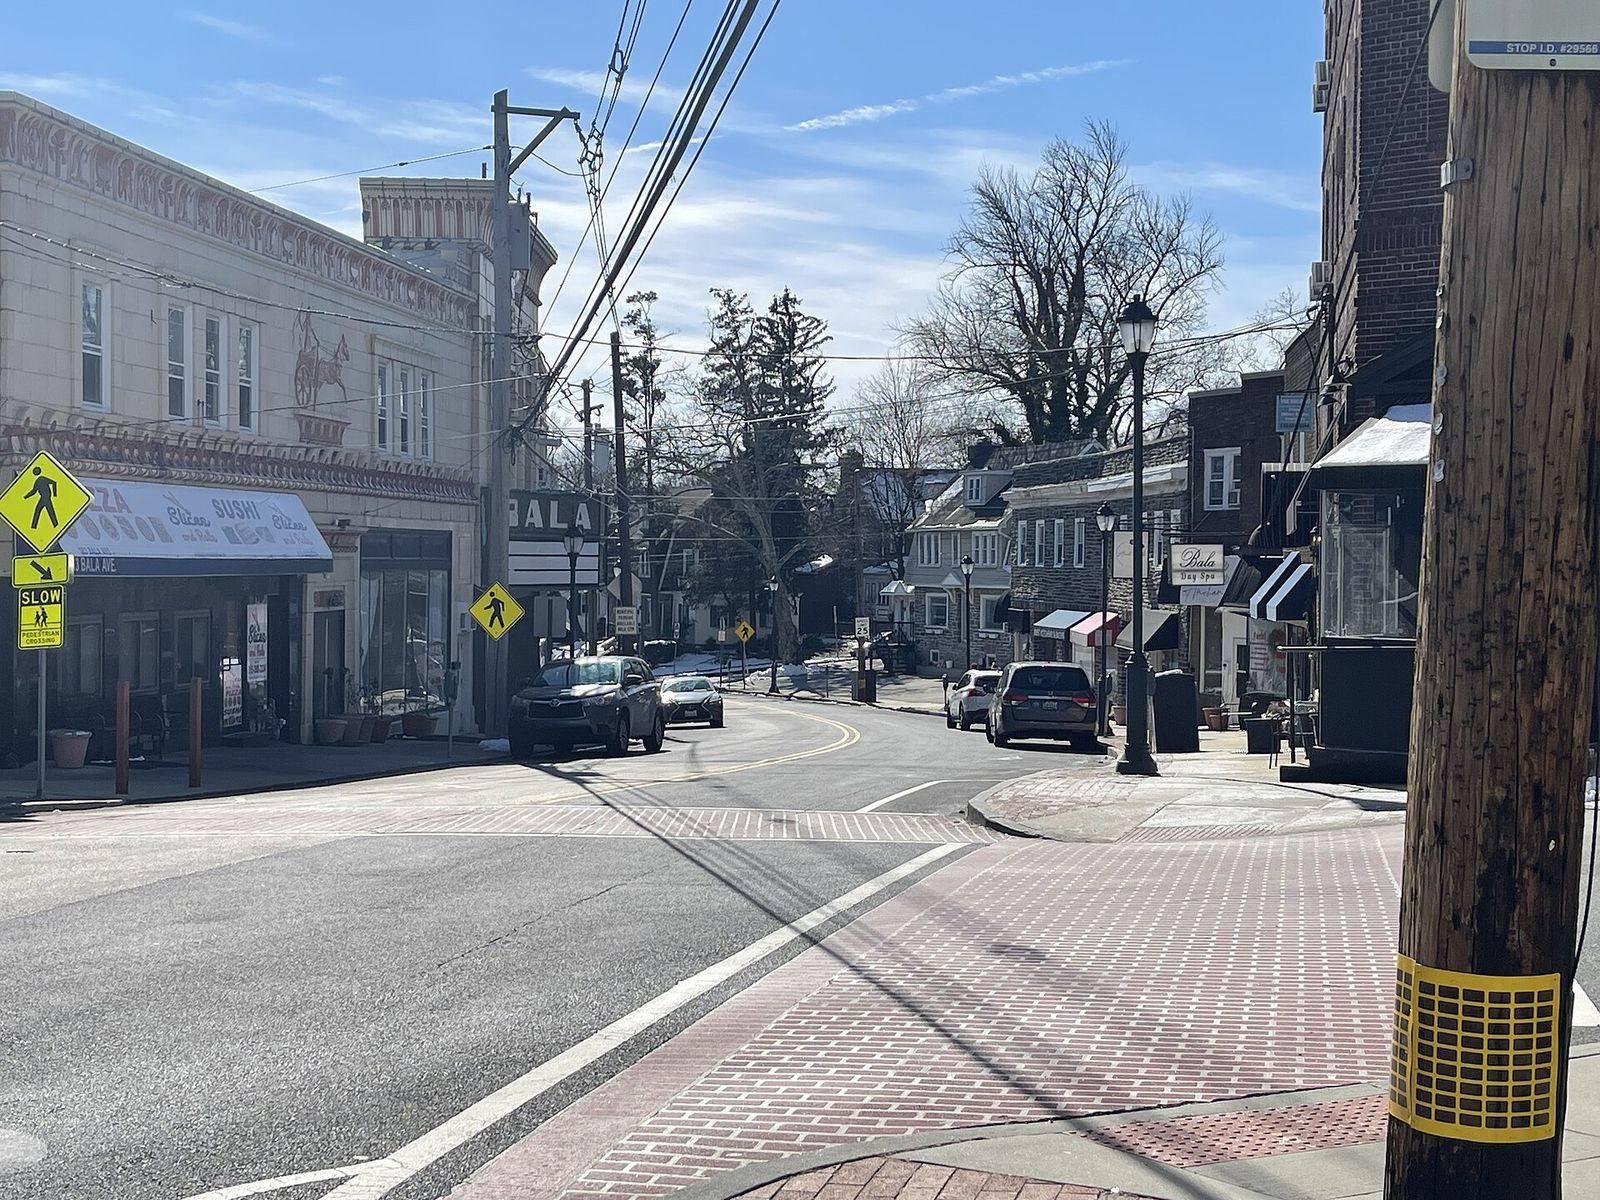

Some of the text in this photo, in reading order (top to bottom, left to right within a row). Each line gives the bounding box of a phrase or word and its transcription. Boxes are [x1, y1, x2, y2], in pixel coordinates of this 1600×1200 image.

[1506, 43, 1537, 53] STOP
[1540, 43, 1557, 53] I.D.
[211, 499, 261, 520] SUSHI
[509, 498, 592, 530] BALA
[80, 557, 100, 573] BALA
[1180, 547, 1217, 568] Bala
[1181, 572, 1197, 583] Day
[1200, 572, 1215, 582] Spa
[21, 589, 61, 605] SLOW
[22, 630, 60, 638] PEDESTRIAN
[857, 627, 869, 635] 25
